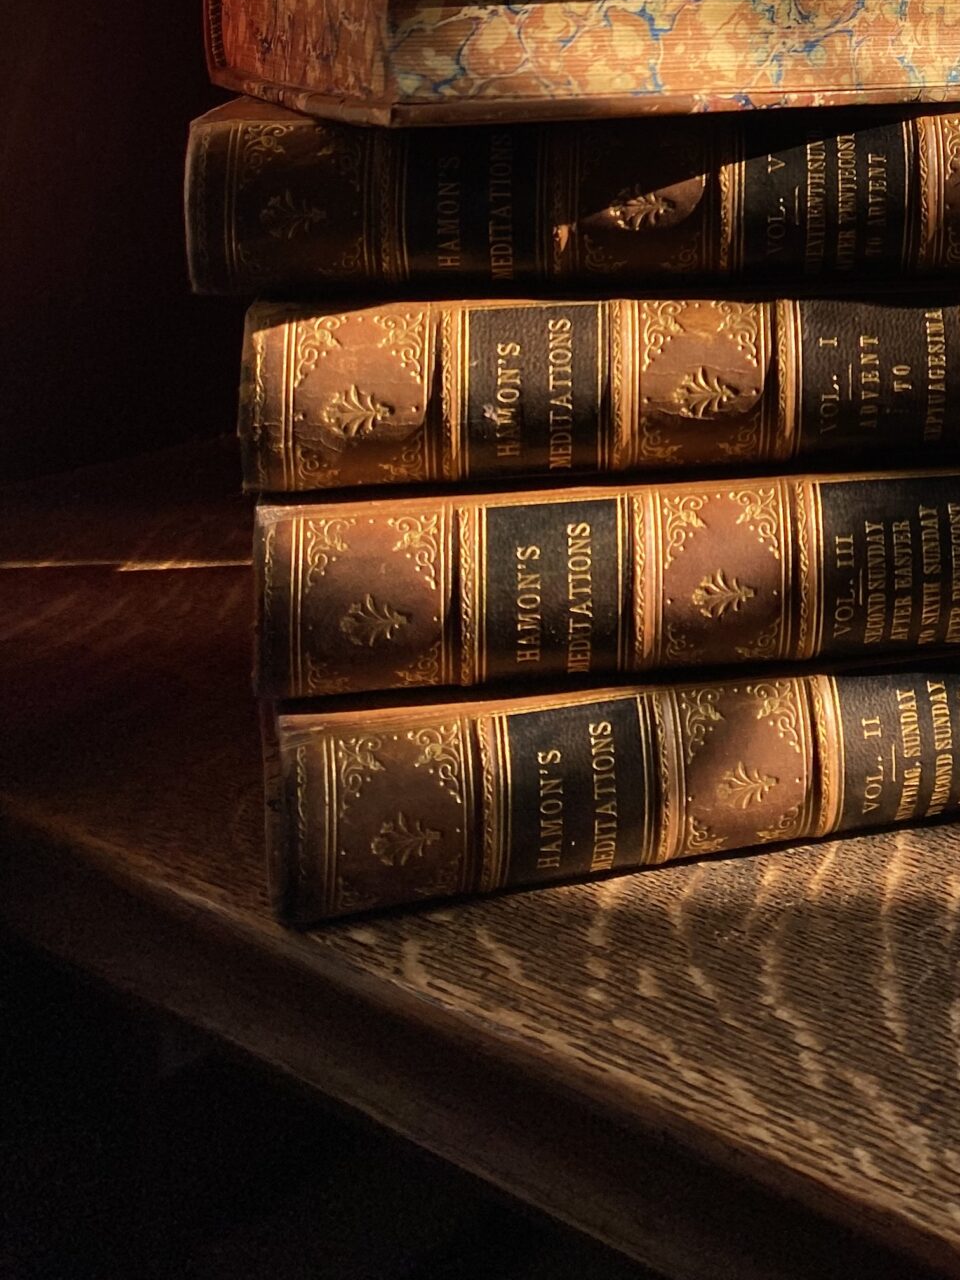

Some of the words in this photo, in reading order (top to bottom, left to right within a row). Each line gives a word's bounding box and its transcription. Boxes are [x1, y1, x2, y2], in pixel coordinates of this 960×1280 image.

[766, 153, 787, 173] V
[836, 132, 858, 224] PENTECOST
[867, 152, 888, 226] ADVENT
[436, 155, 461, 268] HAMON'S
[488, 131, 513, 280] MEDITATIONS
[766, 196, 787, 255] VOL.
[818, 336, 839, 347] I
[496, 342, 521, 457] HAMON'S
[548, 318, 573, 468] MEDITATIONS
[819, 375, 840, 433] VOL.
[859, 334, 881, 429] ADVENT
[891, 363, 913, 393] TO
[834, 533, 855, 569] III
[864, 519, 887, 590] SUNDAY
[891, 519, 913, 590] EASTER
[918, 504, 941, 575] SUNDAY
[516, 545, 541, 664] HAMON'S
[566, 522, 593, 674] MEDITATIONS
[832, 579, 856, 641] VOL.
[863, 592, 887, 645] SECOND
[889, 595, 913, 641] AFTER
[920, 582, 941, 626] SIXTH
[861, 715, 882, 739] II
[896, 688, 922, 758] SUNDAY
[926, 680, 953, 751] SUNDAY
[536, 749, 564, 870] HAMON'S
[588, 720, 618, 873] MEDITATIONS
[861, 755, 884, 816] VOL.
[928, 753, 953, 805] SECOND
